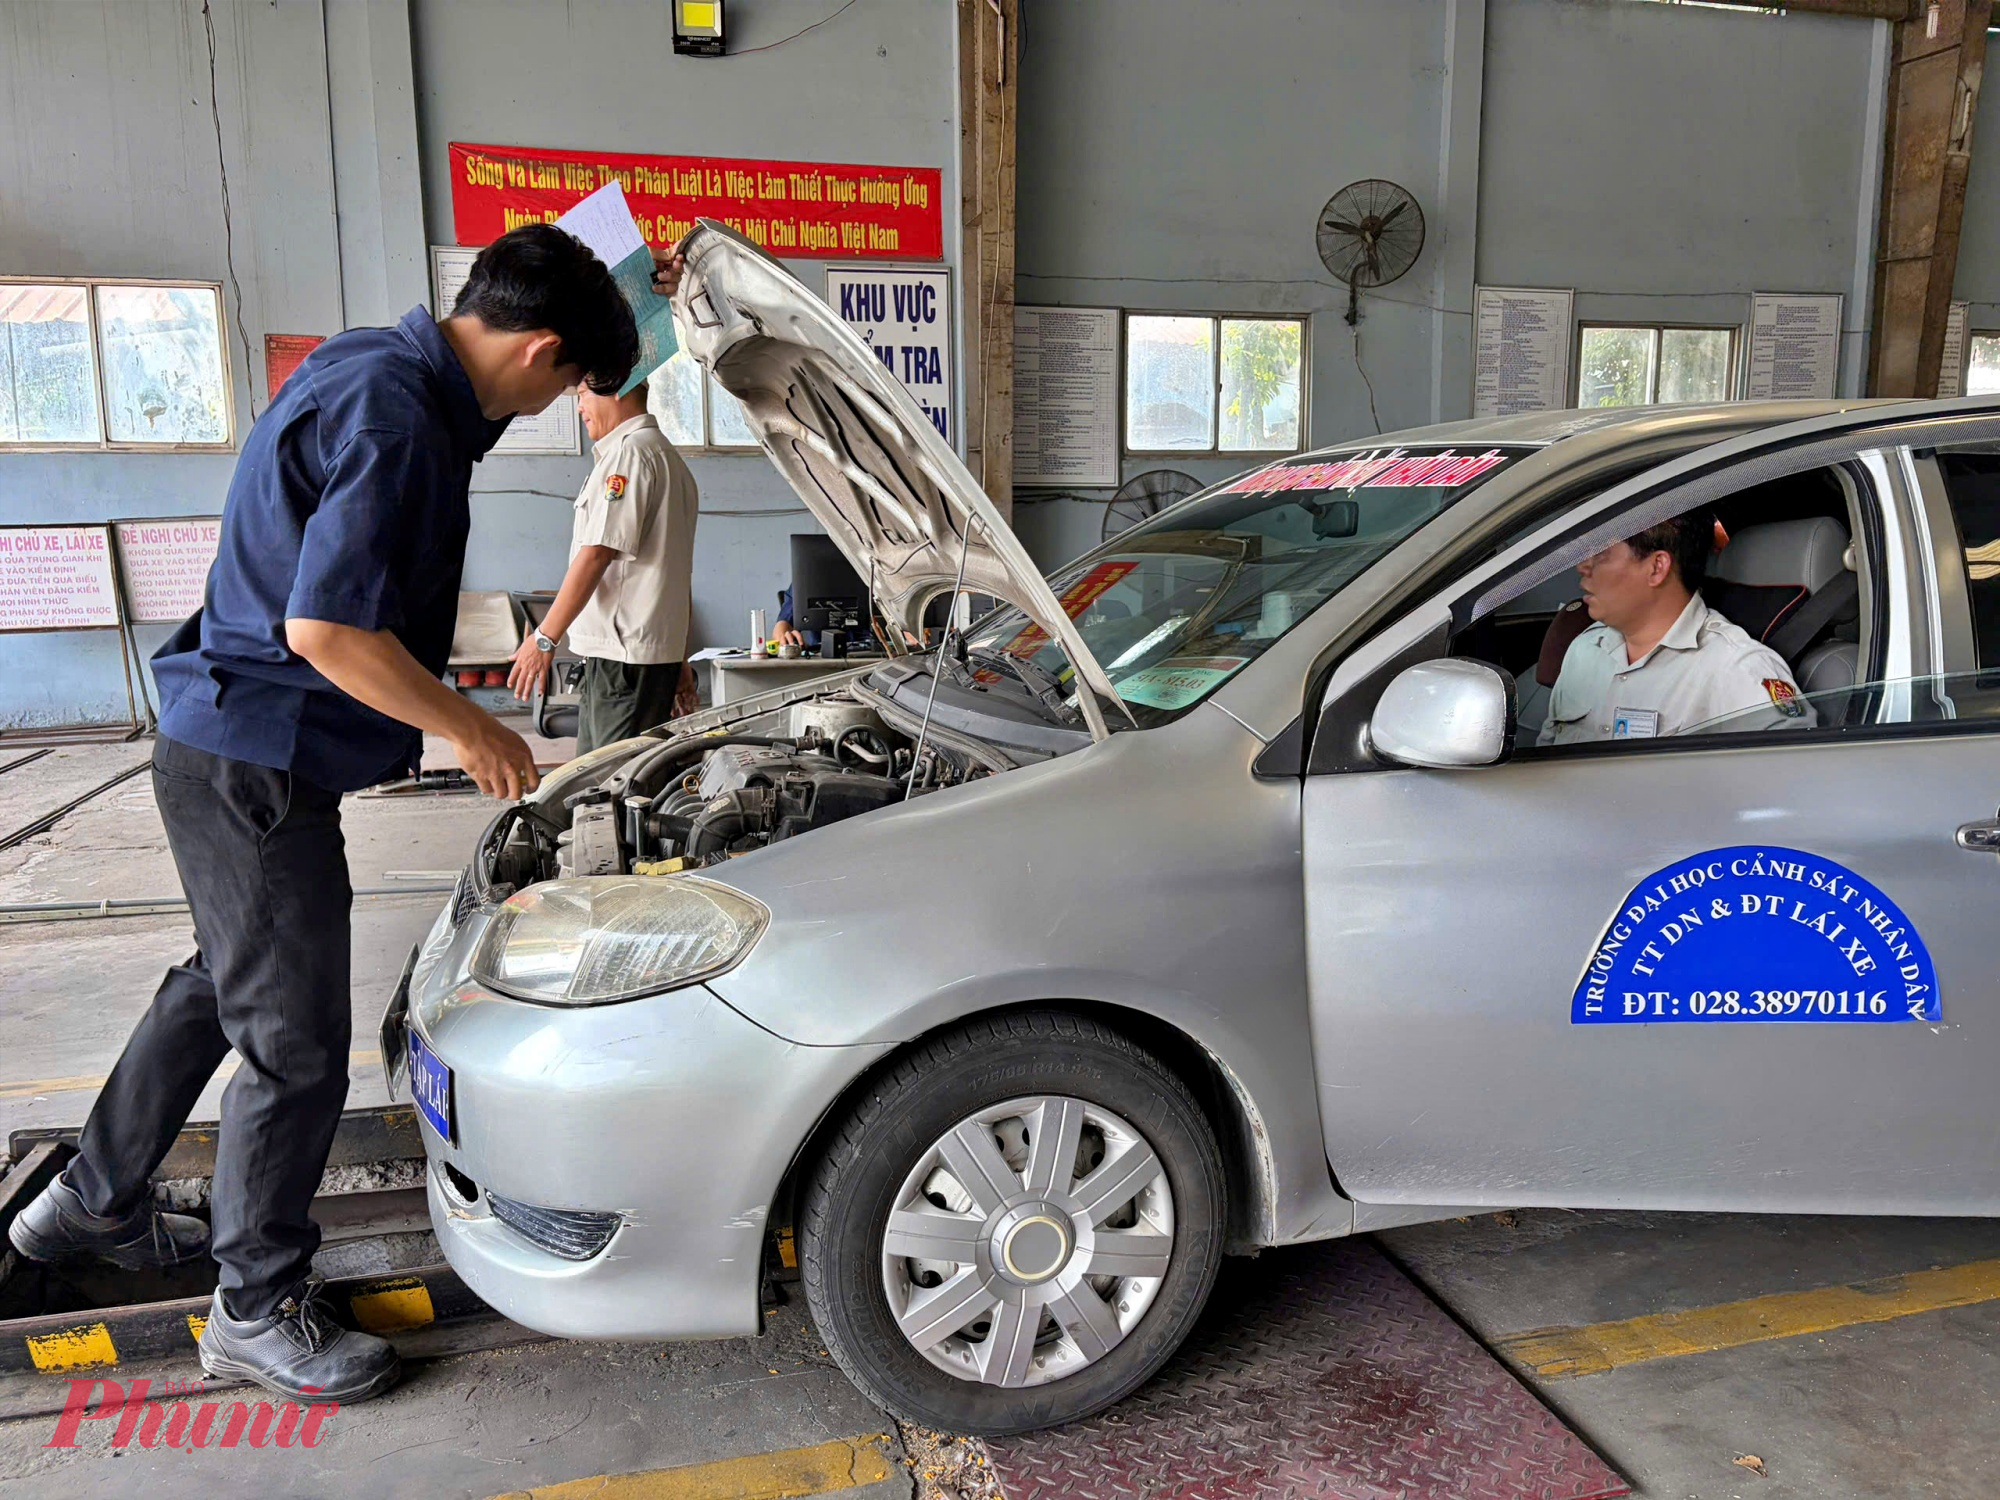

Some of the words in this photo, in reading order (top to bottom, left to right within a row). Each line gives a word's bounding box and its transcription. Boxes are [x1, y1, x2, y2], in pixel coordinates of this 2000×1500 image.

[466, 152, 504, 190] Sống
[506, 159, 526, 188] Và
[529, 160, 560, 189] Làm
[563, 163, 594, 197] Việc
[634, 166, 670, 198] Pháp
[673, 167, 702, 202] Luật
[705, 169, 722, 197] Là
[725, 170, 754, 204] Việc
[757, 171, 786, 200] Làm
[789, 170, 823, 202] Thiết
[825, 175, 856, 208] Thực
[859, 174, 900, 210] Hưởng
[903, 172, 928, 209] Ứng
[745, 218, 767, 246] Hội
[771, 217, 796, 247] Chủ
[799, 221, 838, 251] Nghĩa
[840, 222, 866, 255] Việt
[868, 223, 899, 250] Nam
[840, 283, 886, 323] KHU
[892, 281, 936, 332] VỰC
[901, 346, 943, 384] TRA
[1416, 449, 1508, 487] DÂN
[0, 537, 12, 556] HỊ
[15, 531, 40, 552] CHỦ
[43, 535, 63, 553] XE,
[66, 531, 85, 550] LÁI
[87, 535, 104, 550] XE
[122, 522, 138, 545] ĐỀ
[141, 528, 172, 547] NGHỊ
[173, 521, 198, 543] CHỦ
[201, 527, 217, 542] XE
[4, 556, 24, 564] QUA
[27, 556, 60, 564] TRUNG
[0, 585, 20, 595] HÂN
[1584, 921, 1632, 1016] TRƯỜNG
[1627, 885, 1671, 925] ĐẠI
[1669, 862, 1725, 895] HỌC
[1731, 852, 1807, 882] CẢNH
[1808, 870, 1859, 904] SÁT
[1855, 897, 1913, 962] NHÂN
[1900, 962, 1931, 1022] DÂN
[1631, 940, 1665, 980] TT
[1659, 907, 1705, 946] DN
[1710, 898, 1733, 921] &
[1740, 894, 1784, 915] ĐT
[1789, 901, 1845, 944] LÁI
[1840, 938, 1877, 978] XE
[1622, 991, 1680, 1017] ĐT:
[1689, 990, 1887, 1017] 028.38970116
[411, 1049, 427, 1096] TẬP
[427, 1073, 448, 1122] LÁI
